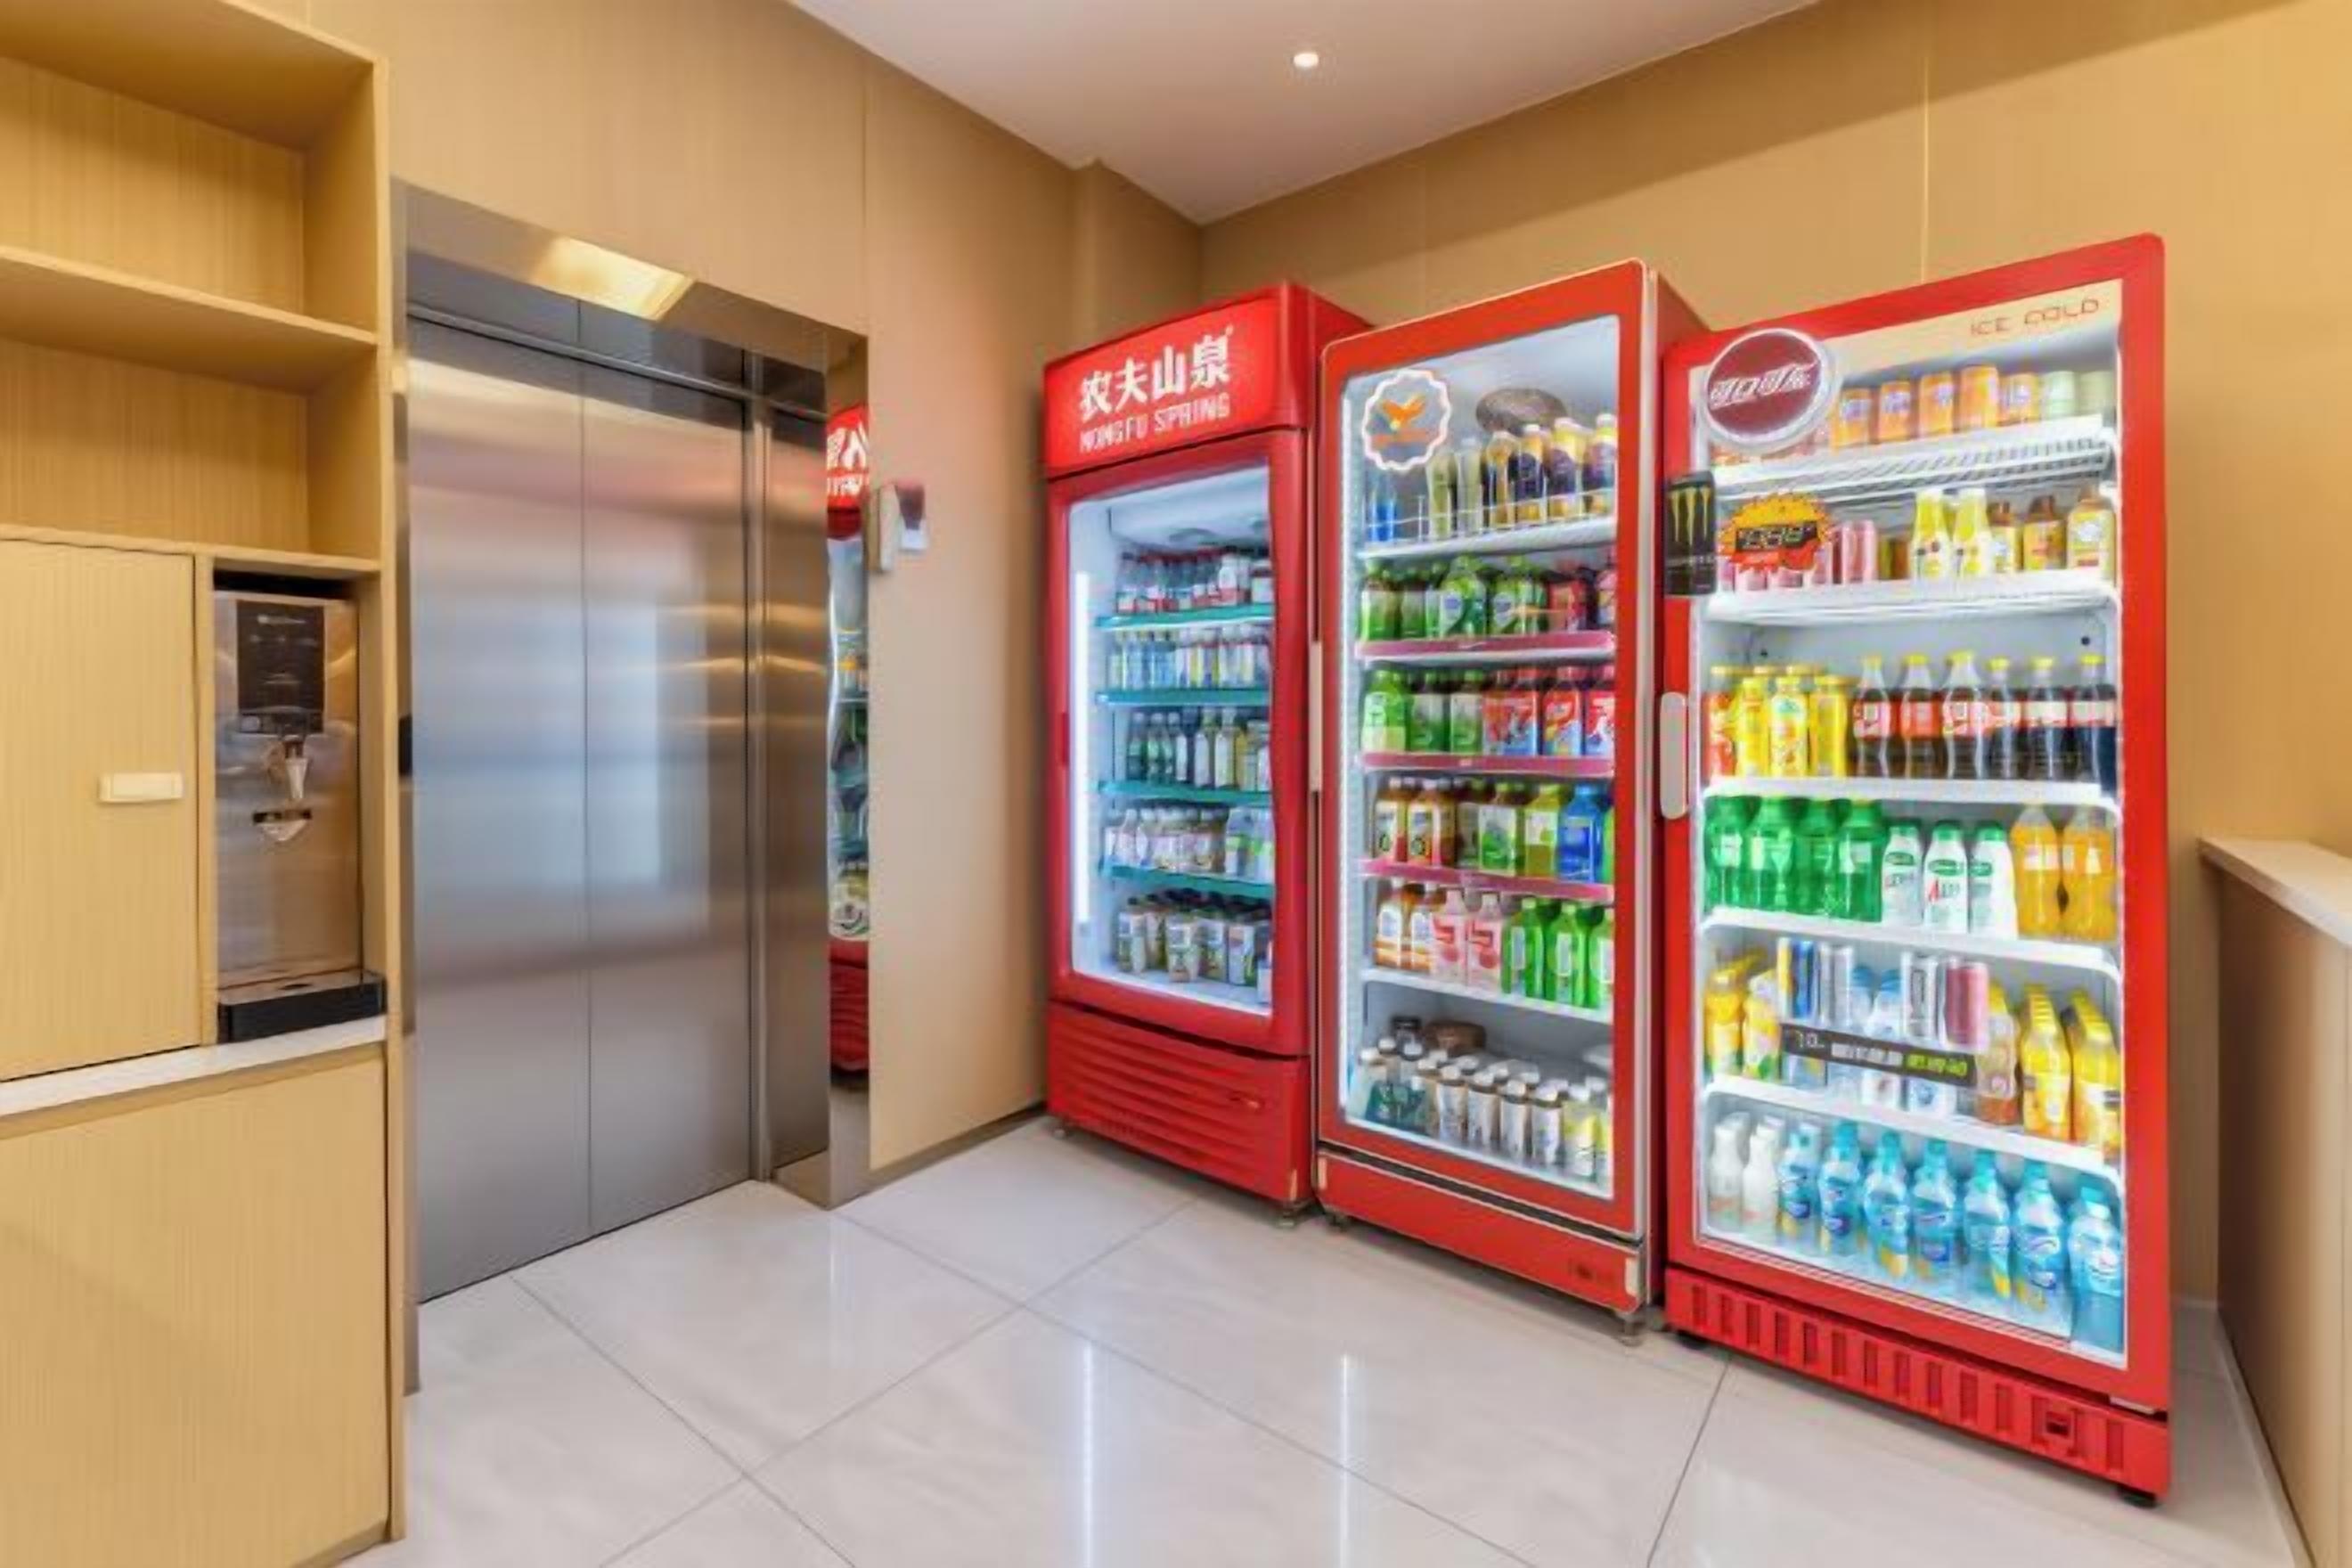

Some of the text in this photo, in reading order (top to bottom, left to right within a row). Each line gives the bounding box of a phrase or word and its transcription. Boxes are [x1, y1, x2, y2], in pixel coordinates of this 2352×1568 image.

[1970, 298, 2100, 336] ICE COLD
[1078, 333, 1231, 422] 农夫山泉
[1080, 392, 1230, 453] NONGFU SPRING
